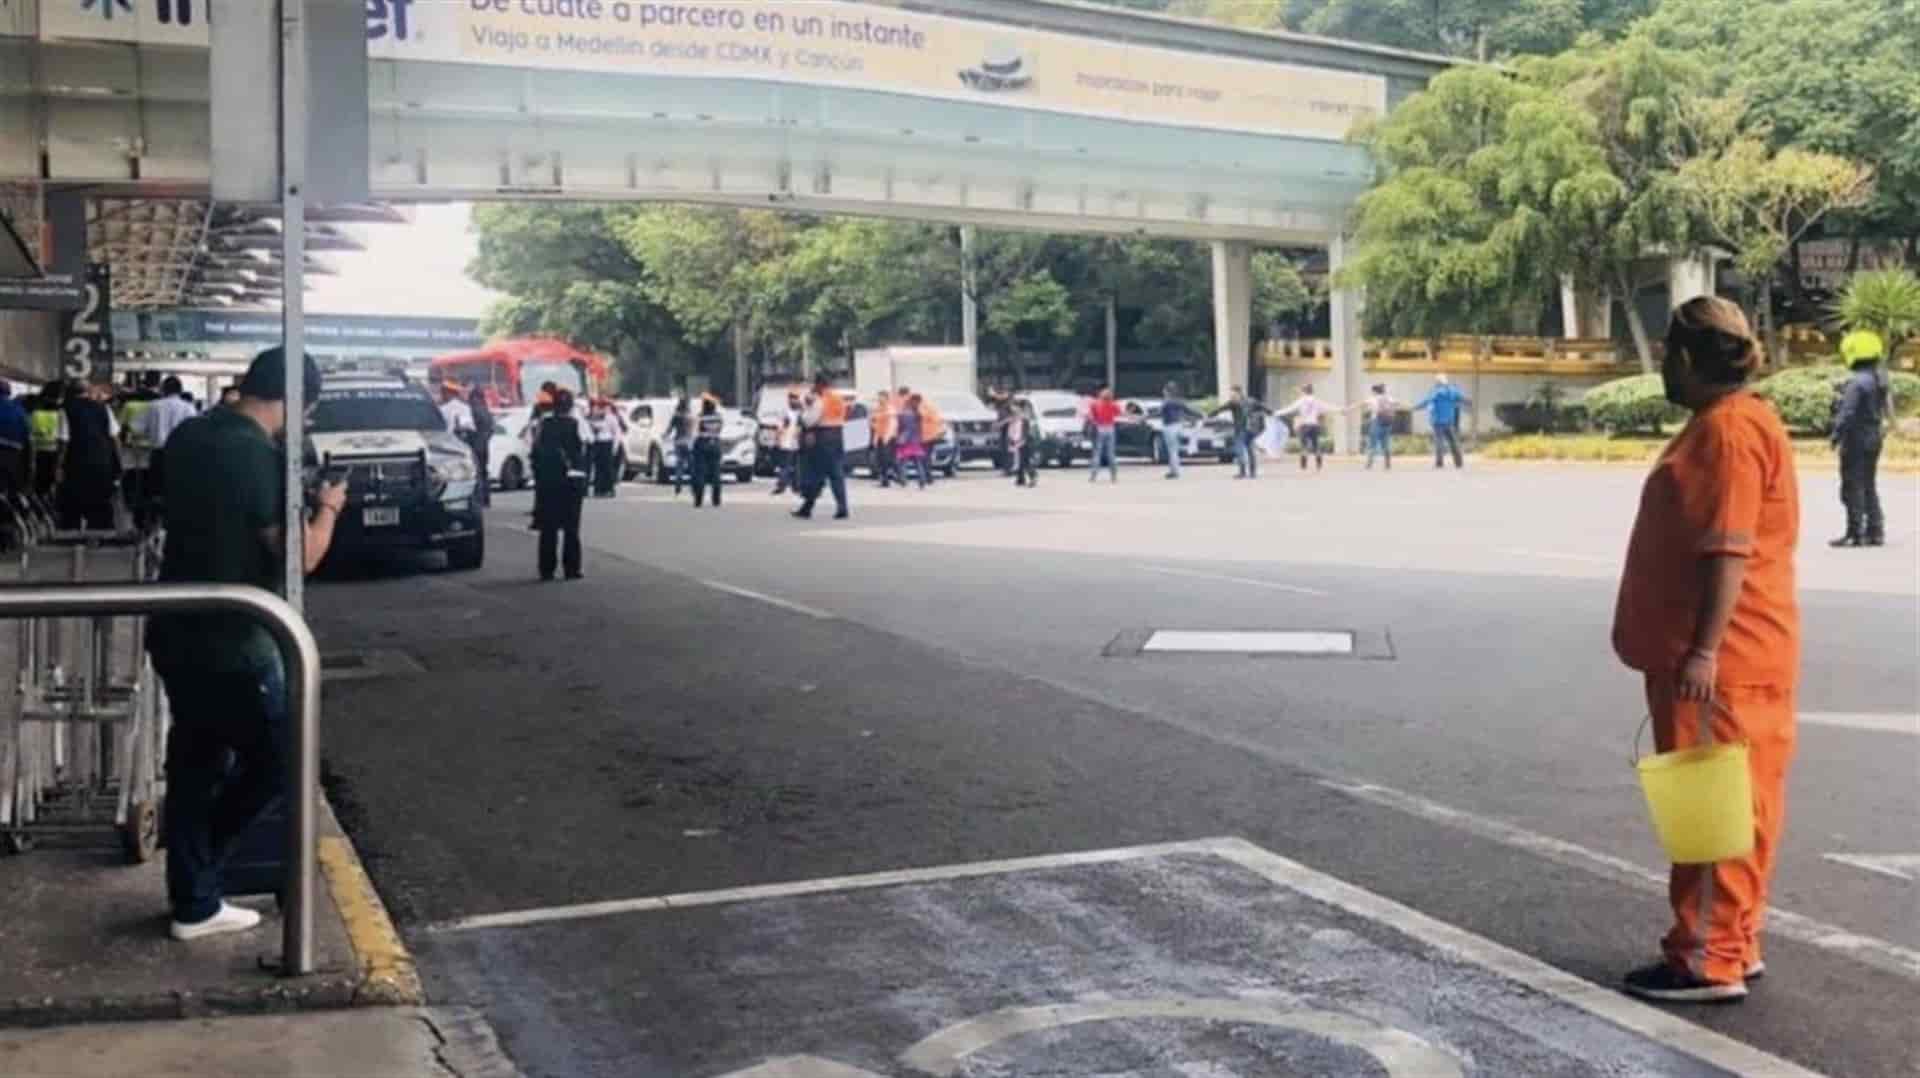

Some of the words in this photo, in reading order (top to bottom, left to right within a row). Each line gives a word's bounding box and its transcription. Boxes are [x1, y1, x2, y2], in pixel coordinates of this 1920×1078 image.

[521, 0, 602, 20] cuate
[613, 2, 631, 22] a
[639, 3, 745, 29] parcero
[753, 11, 785, 32] en
[792, 15, 824, 37] un
[831, 16, 926, 49] instante
[535, 32, 551, 49] a
[72, 283, 99, 334] 2
[65, 338, 92, 380] 3
